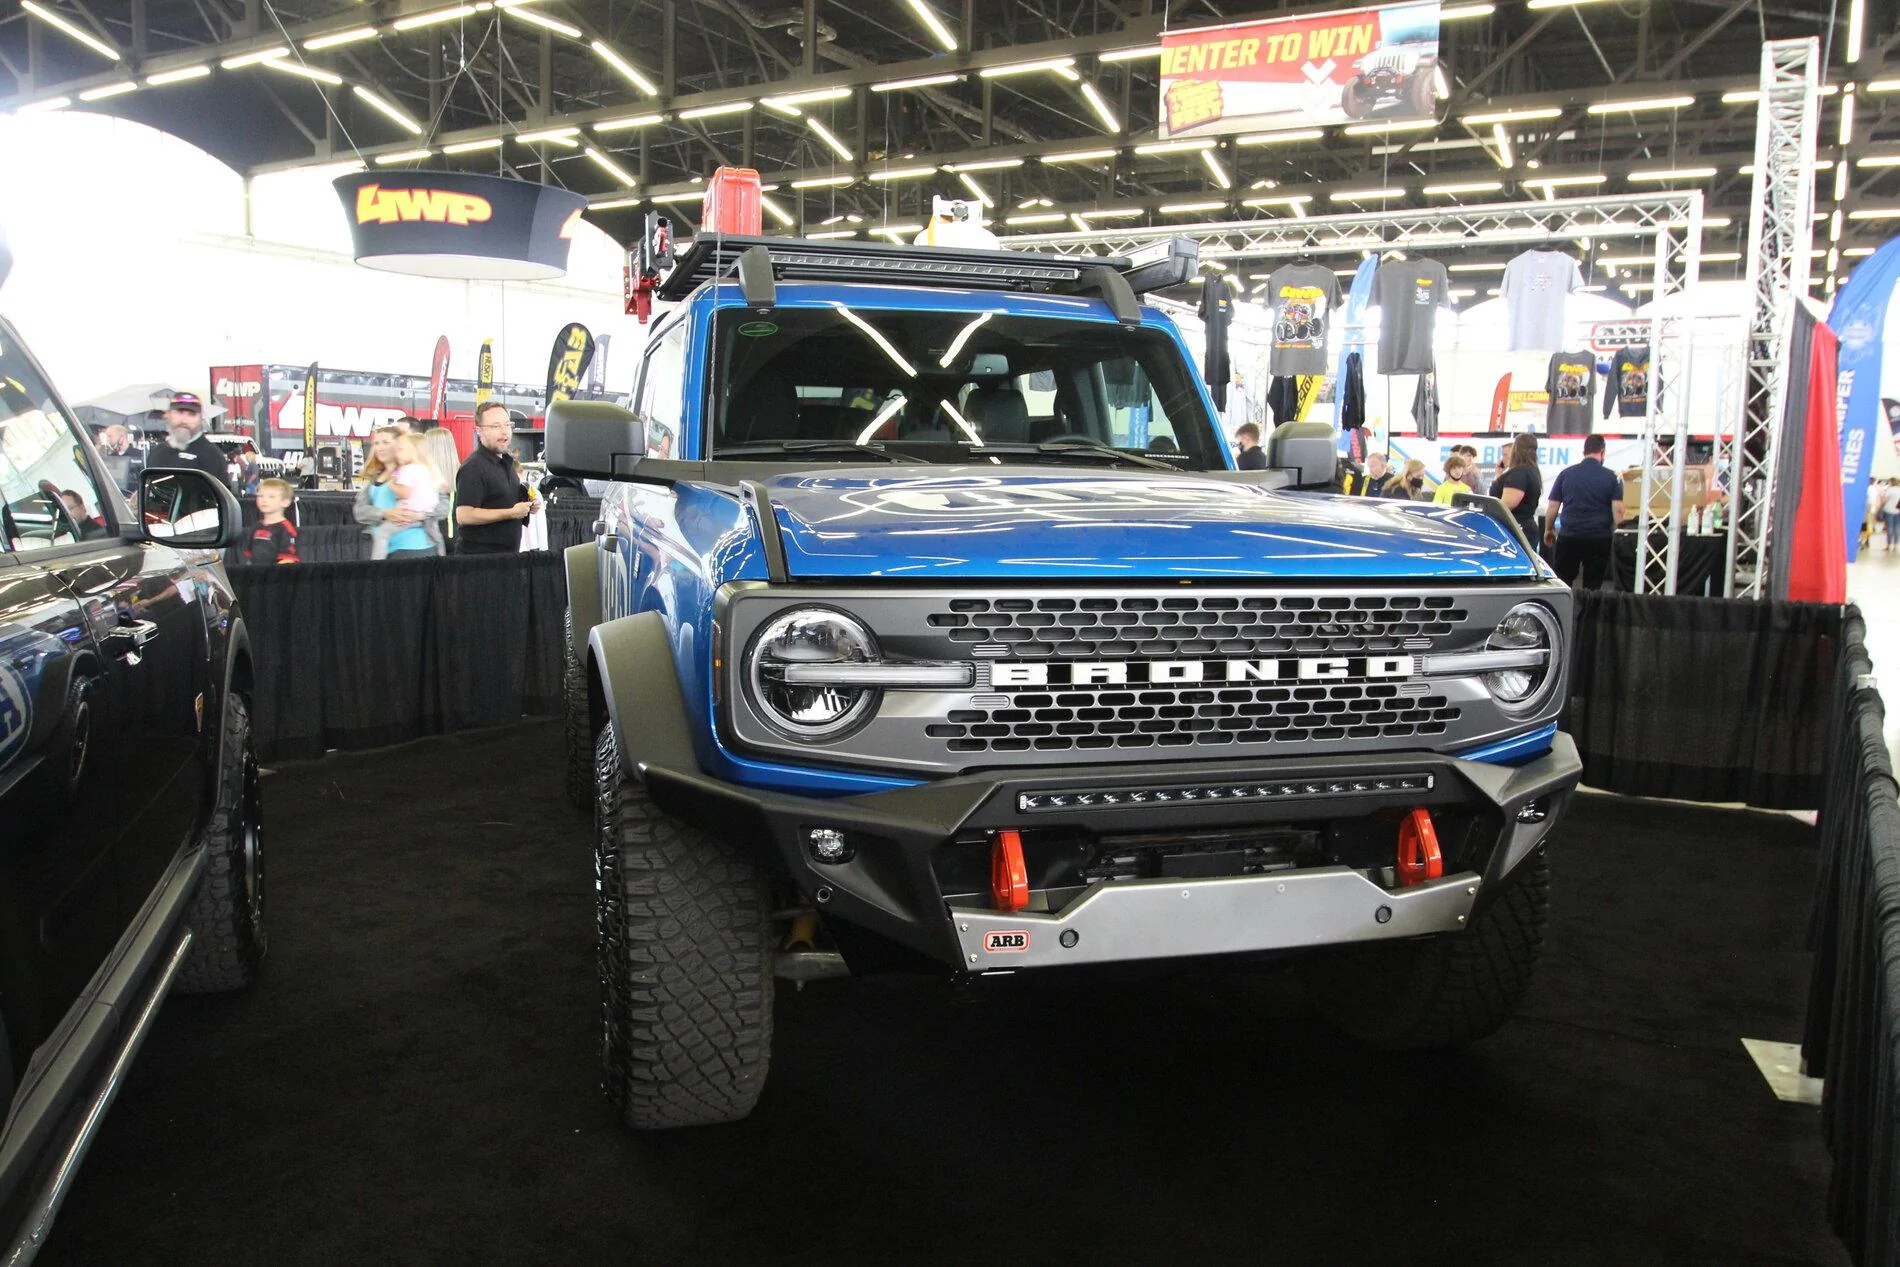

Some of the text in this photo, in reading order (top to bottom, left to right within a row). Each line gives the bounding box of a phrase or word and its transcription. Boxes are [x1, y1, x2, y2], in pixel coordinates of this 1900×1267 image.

[1266, 32, 1303, 63] TO
[1308, 23, 1373, 58] WIN
[356, 183, 493, 225] 4WP
[215, 377, 261, 397] 4WP
[1509, 391, 1549, 401] WELCOM
[1484, 446, 1569, 465] BIEIN
[1841, 428, 1866, 485] TIRES
[990, 656, 1414, 685] BRONCO
[991, 935, 1024, 947] ARB
